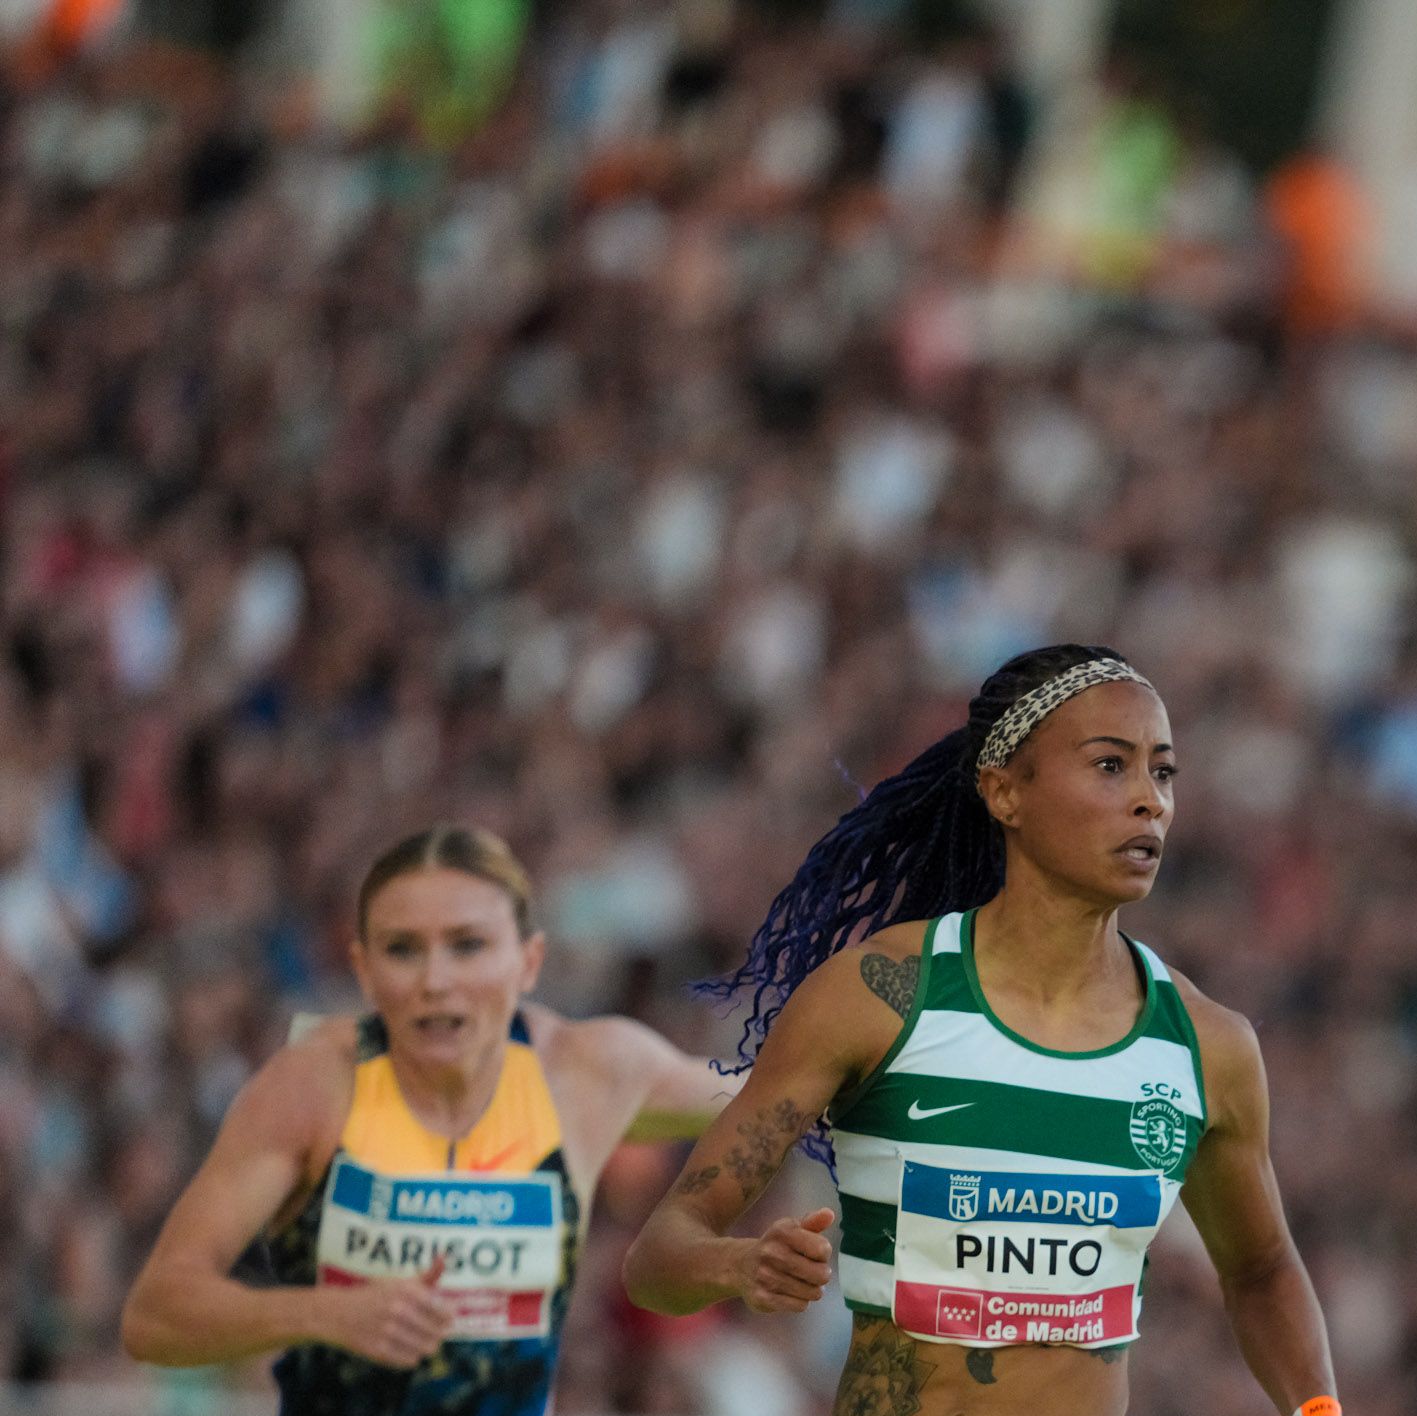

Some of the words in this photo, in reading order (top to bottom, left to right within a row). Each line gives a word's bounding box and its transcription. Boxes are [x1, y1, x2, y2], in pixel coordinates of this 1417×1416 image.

[1141, 1083, 1182, 1100] SCP
[1137, 1102, 1182, 1127] SPORTING
[397, 1189, 514, 1227] MADRID
[988, 1187, 1119, 1224] MADRID
[956, 1234, 1102, 1277] PINTO
[987, 1294, 1104, 1318] Comunidad
[985, 1320, 1018, 1340] de
[1026, 1317, 1104, 1342] Madrid
